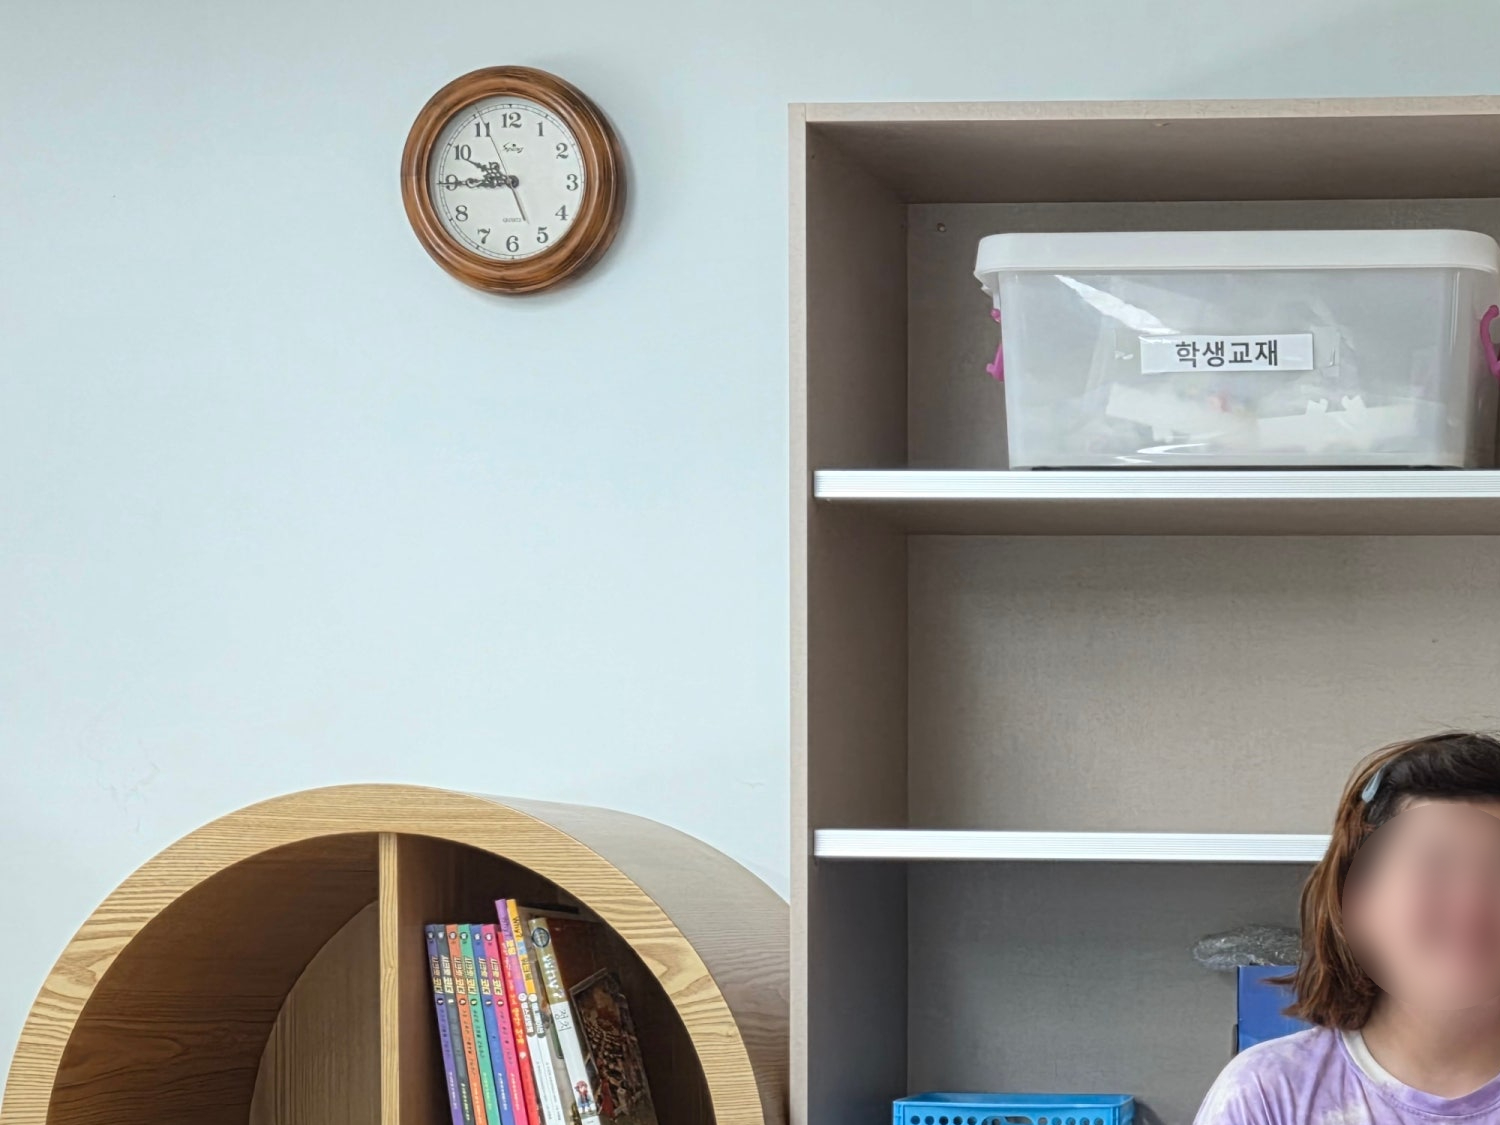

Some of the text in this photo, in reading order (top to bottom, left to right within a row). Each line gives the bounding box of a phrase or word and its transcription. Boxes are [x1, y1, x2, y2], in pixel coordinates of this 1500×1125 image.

[501, 112, 522, 128] 12
[475, 122, 491, 137] 11
[537, 122, 545, 136] 1
[454, 145, 472, 160] 10
[556, 143, 569, 159] 2
[446, 175, 459, 191] 9
[566, 174, 579, 191] 3
[455, 205, 469, 222] 8
[555, 205, 568, 220] 4
[477, 228, 491, 244] 7
[536, 227, 549, 243] 5
[506, 235, 520, 252] 6
[1175, 339, 1278, 368] 학생교재
[512, 915, 523, 938] Why?
[542, 953, 562, 999] Why?
